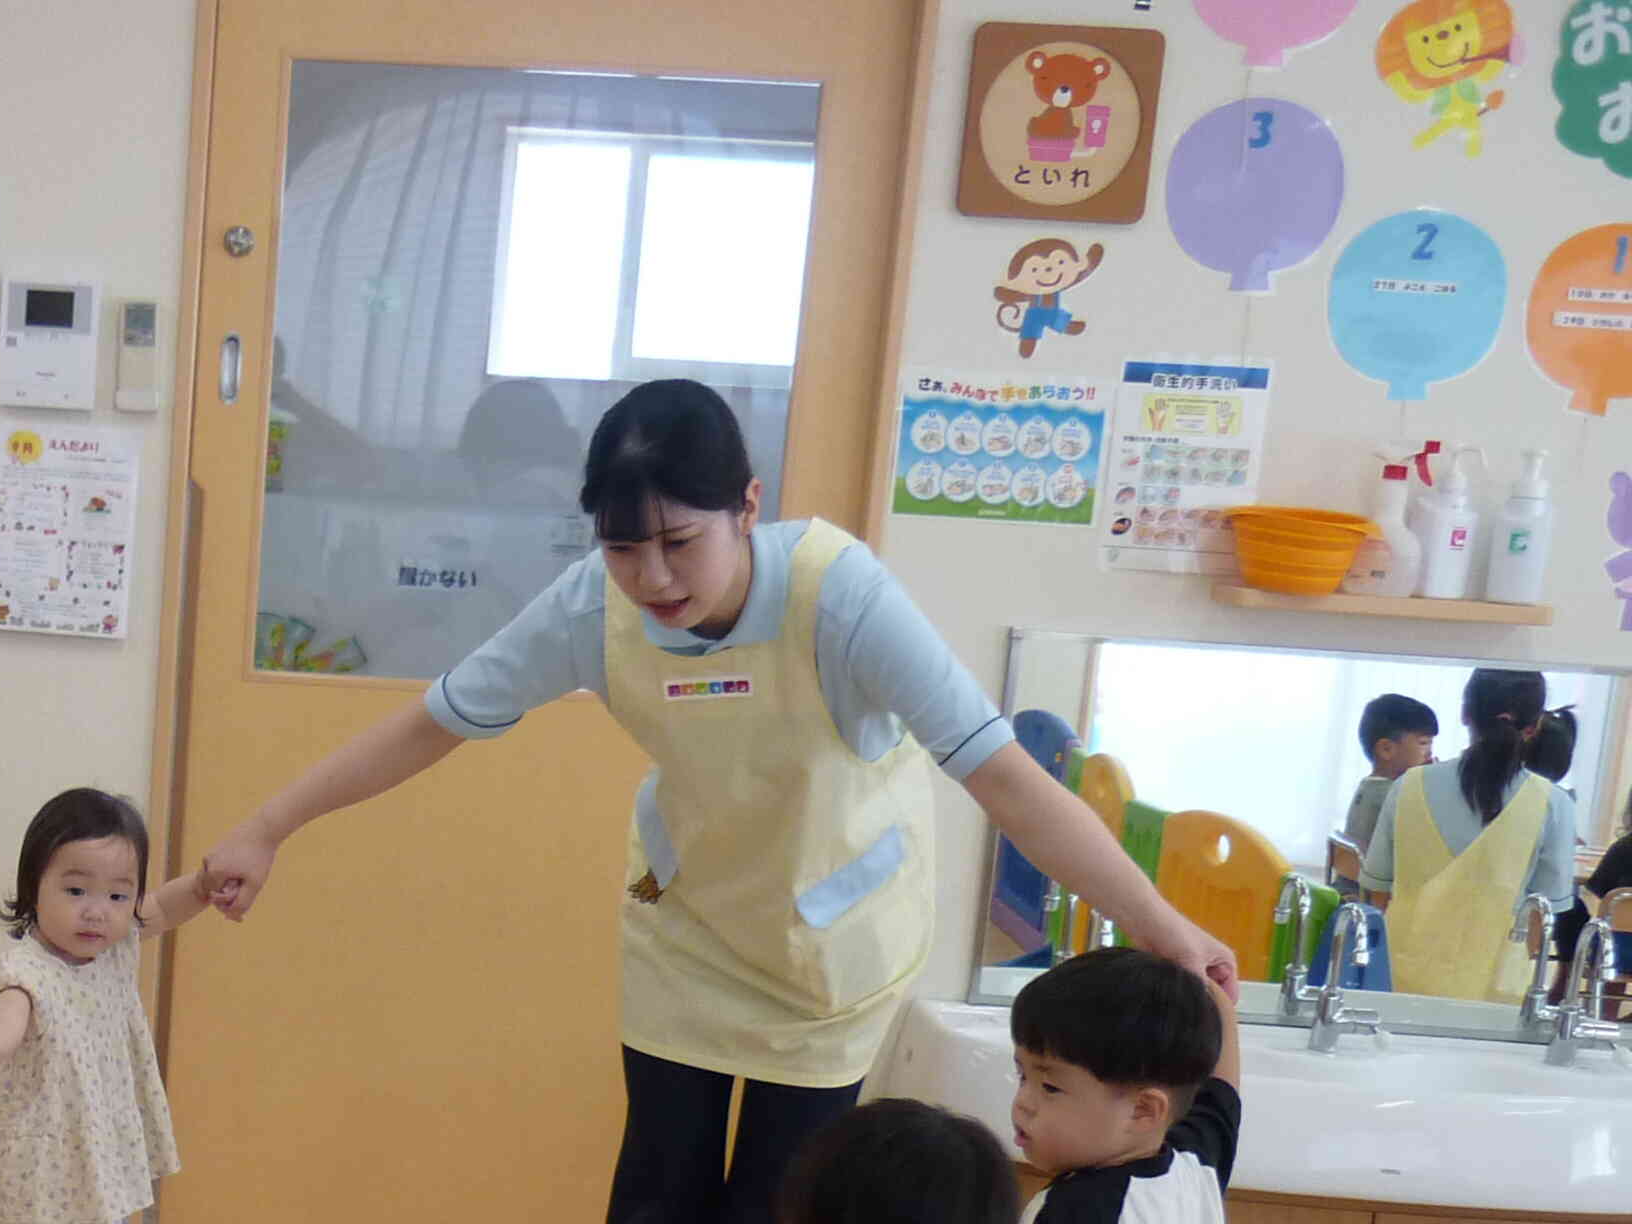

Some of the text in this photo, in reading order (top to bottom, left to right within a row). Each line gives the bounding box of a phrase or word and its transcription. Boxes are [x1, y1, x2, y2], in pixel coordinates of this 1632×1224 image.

[1248, 111, 1274, 149] 3
[1013, 164, 1090, 188] といれ
[1410, 222, 1439, 261] 2
[1612, 235, 1629, 274] 1
